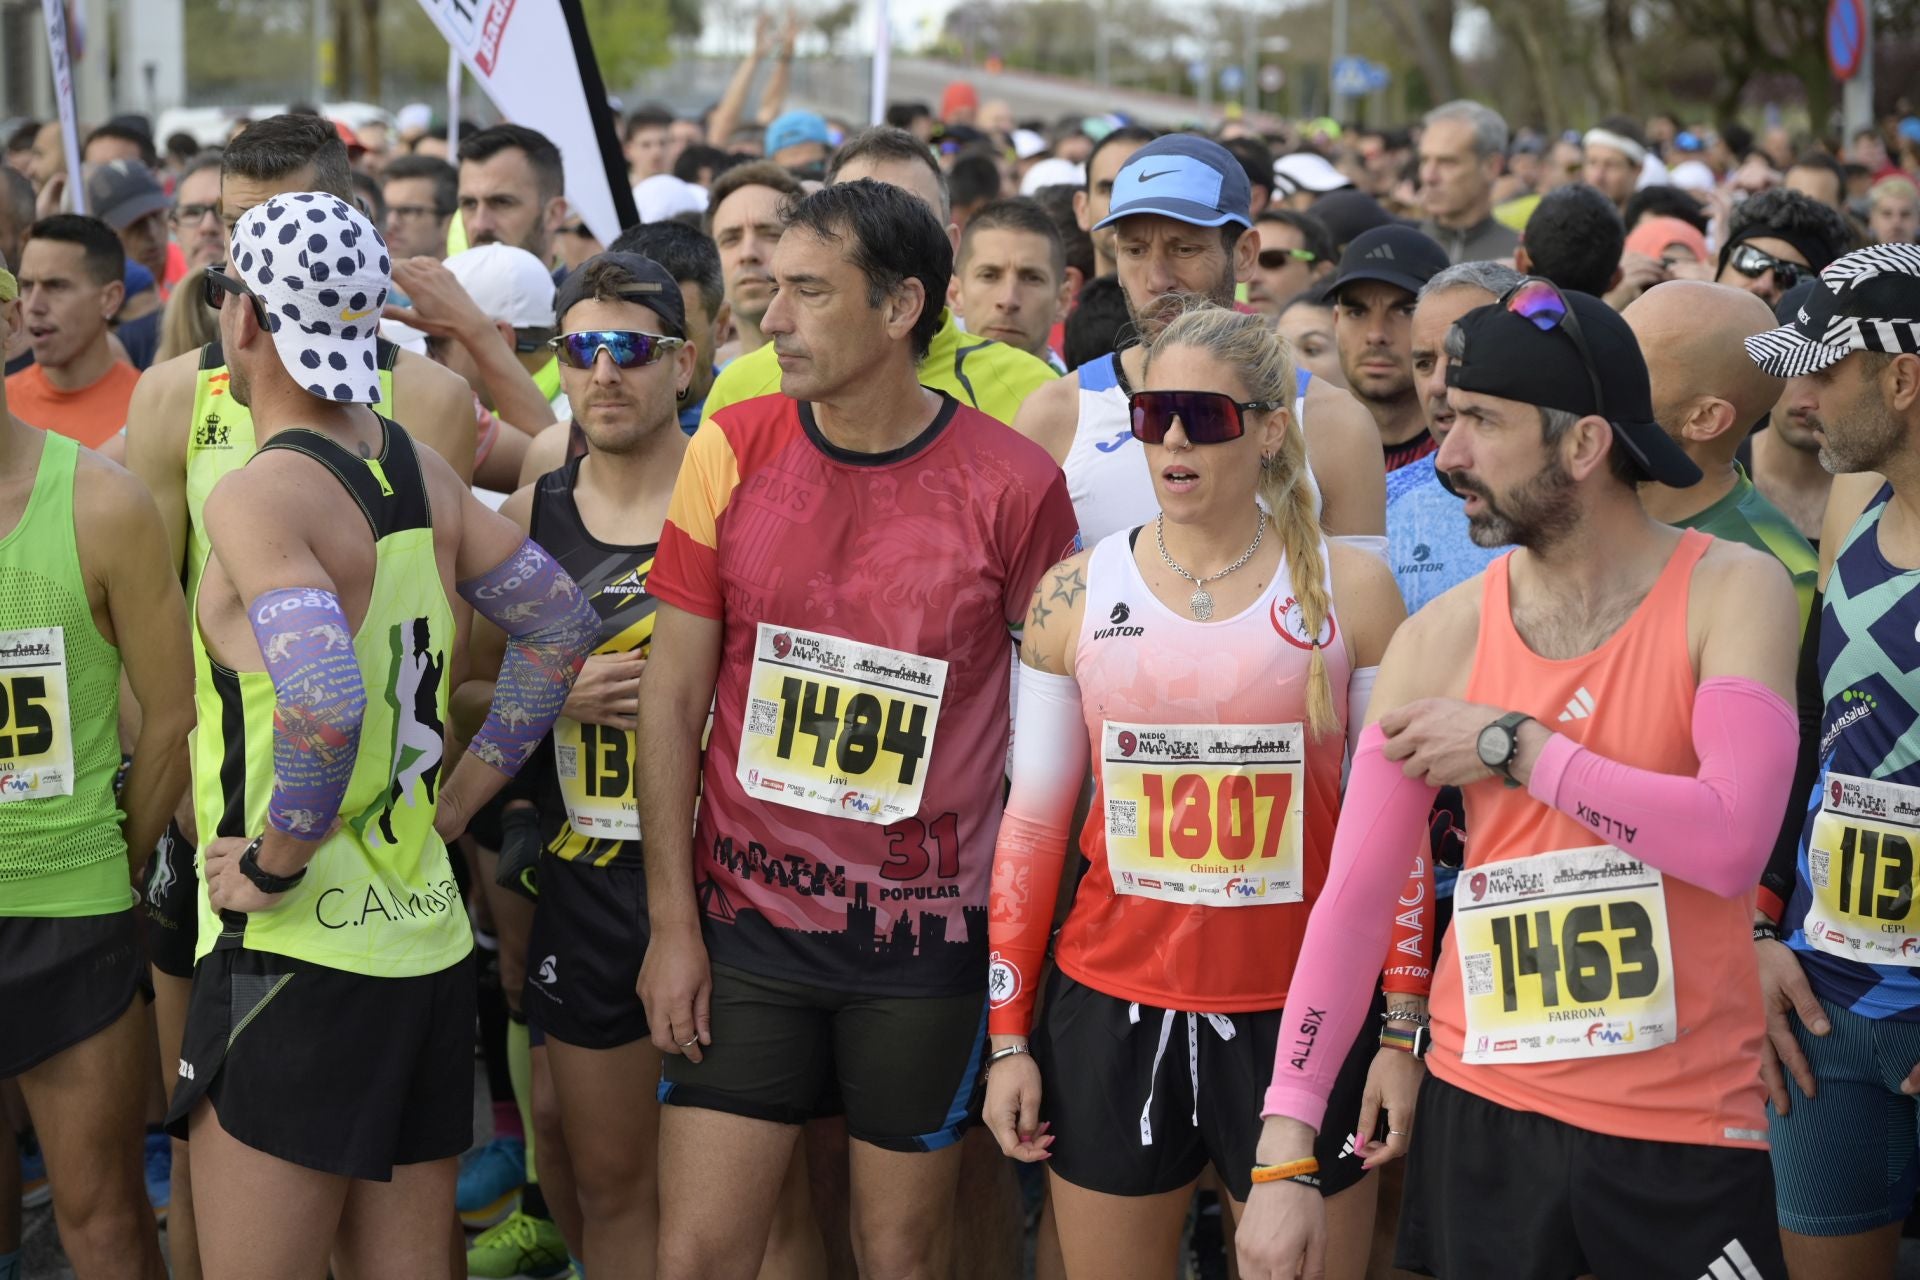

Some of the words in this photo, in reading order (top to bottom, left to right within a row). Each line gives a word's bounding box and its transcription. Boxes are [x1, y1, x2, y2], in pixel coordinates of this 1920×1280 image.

[1398, 562, 1444, 574] VIATOR
[725, 582, 765, 620] TRA
[1094, 626, 1144, 641] VIATOR
[773, 632, 792, 660] 9
[795, 637, 820, 648] MEDIO
[853, 662, 880, 676] CIUDAD
[777, 676, 928, 785] 1484
[1139, 732, 1166, 740] MEDIO
[1118, 731, 1138, 757] 9
[1208, 746, 1238, 754] CIUDAD
[1240, 746, 1250, 754] DE
[1252, 745, 1291, 753] BADAJOZ
[580, 723, 639, 799] 13
[829, 775, 848, 786] Javi
[1844, 783, 1860, 791] MEDIO
[1831, 780, 1843, 808] 9
[1142, 773, 1292, 860] 1807
[1556, 801, 1638, 844] ALLSIX
[879, 812, 960, 881] 31
[1190, 863, 1229, 874] Chinita
[1233, 863, 1246, 874] 14
[1490, 867, 1513, 877] MEDIO
[879, 885, 960, 901] POPULAR
[1198, 887, 1220, 895] Unicaja
[1470, 872, 1488, 902] 9
[1491, 901, 1659, 1013] 1463
[1384, 965, 1430, 979] VIATOR
[1549, 1007, 1606, 1022] FARRONA
[1291, 1006, 1327, 1070] ALLSIX
